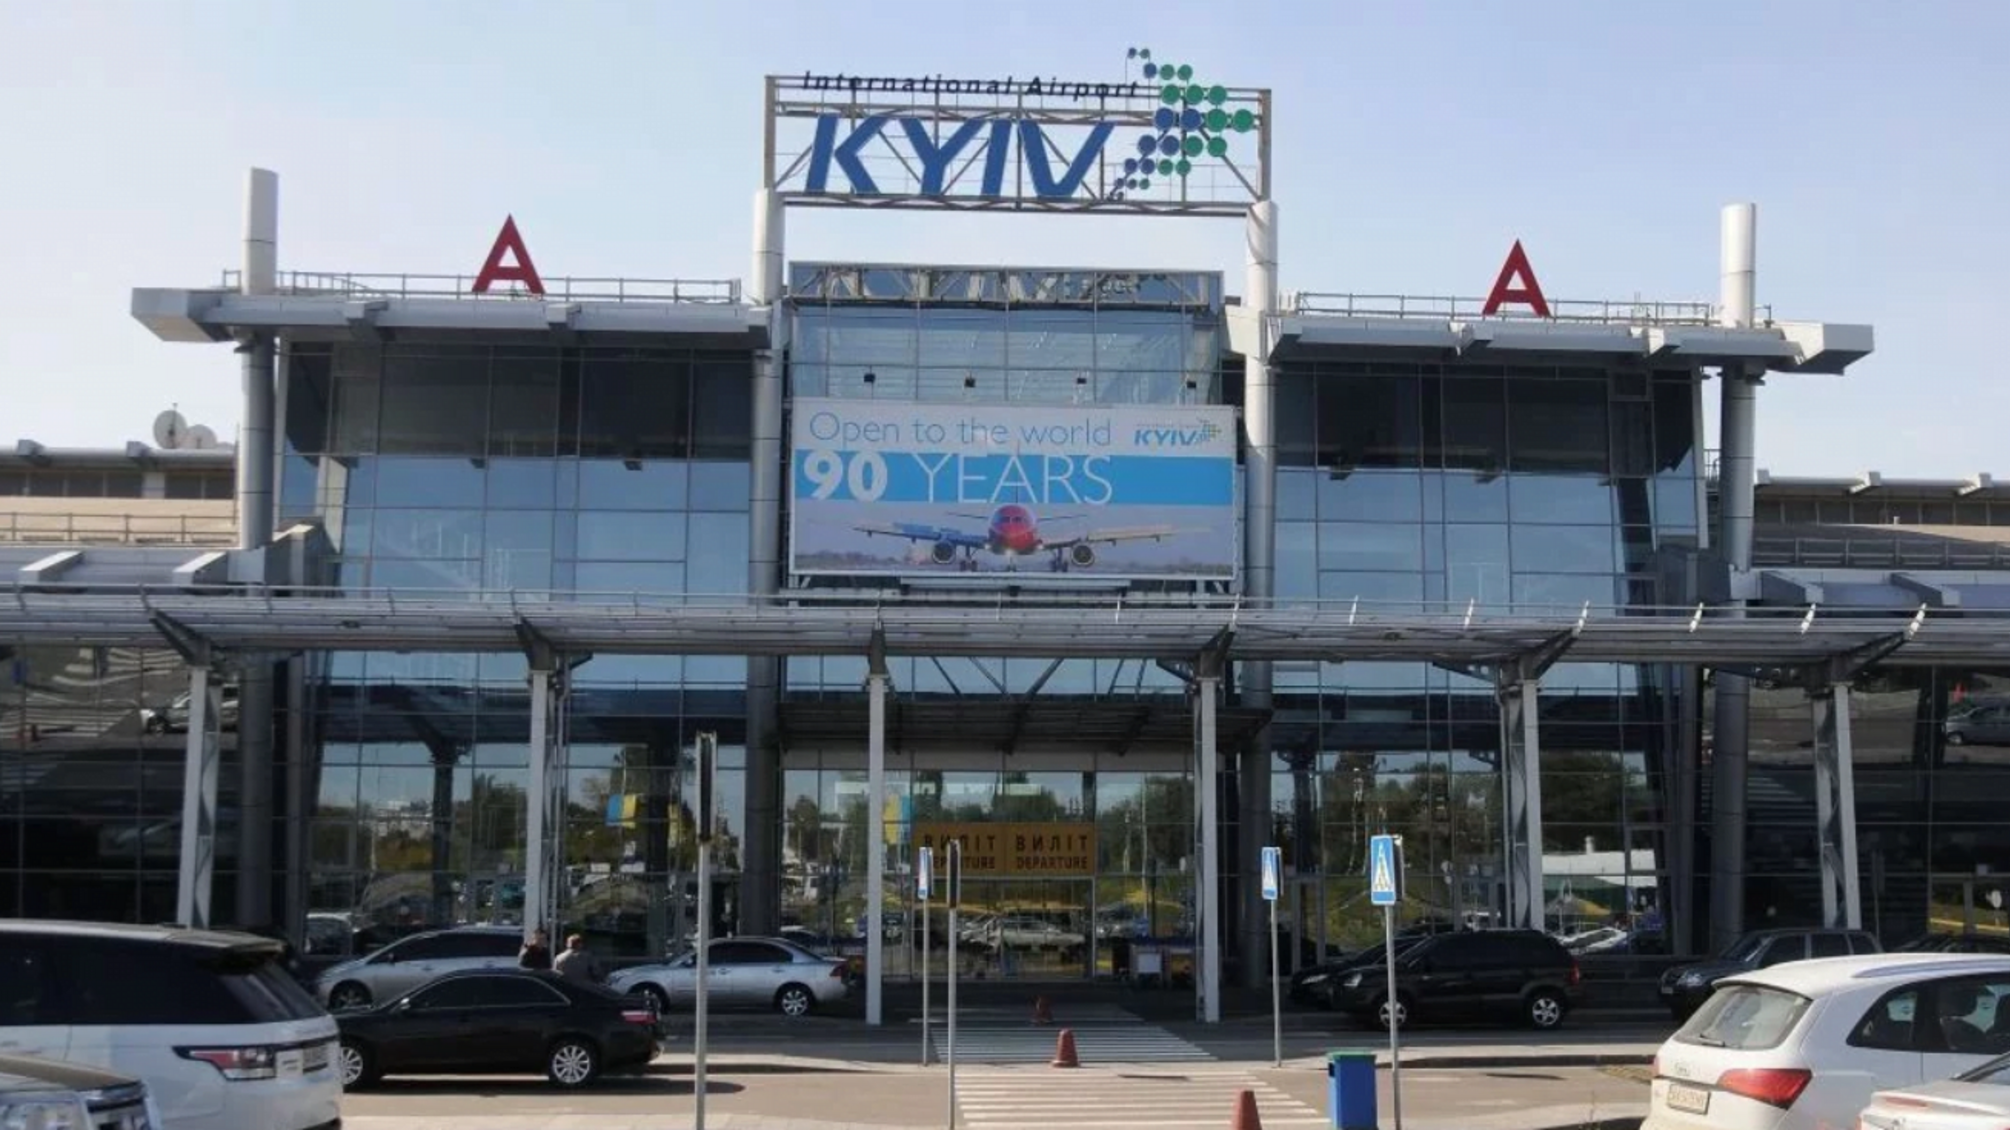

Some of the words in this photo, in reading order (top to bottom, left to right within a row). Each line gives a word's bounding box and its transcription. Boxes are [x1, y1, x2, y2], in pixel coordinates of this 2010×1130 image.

[803, 70, 1013, 95] International
[1025, 76, 1138, 102] Airport
[804, 112, 1115, 199] KYIV
[472, 213, 546, 294] A
[1482, 238, 1551, 317] A
[809, 411, 899, 448] Open
[912, 419, 945, 444] to
[957, 417, 1009, 446] the
[1021, 417, 1111, 447] world
[1134, 429, 1197, 447] KYIV
[803, 450, 888, 501] 90
[911, 452, 1113, 504] YEARS
[1015, 834, 1088, 851] ВИЛІТ
[1016, 855, 1088, 870] DEPARTURE
